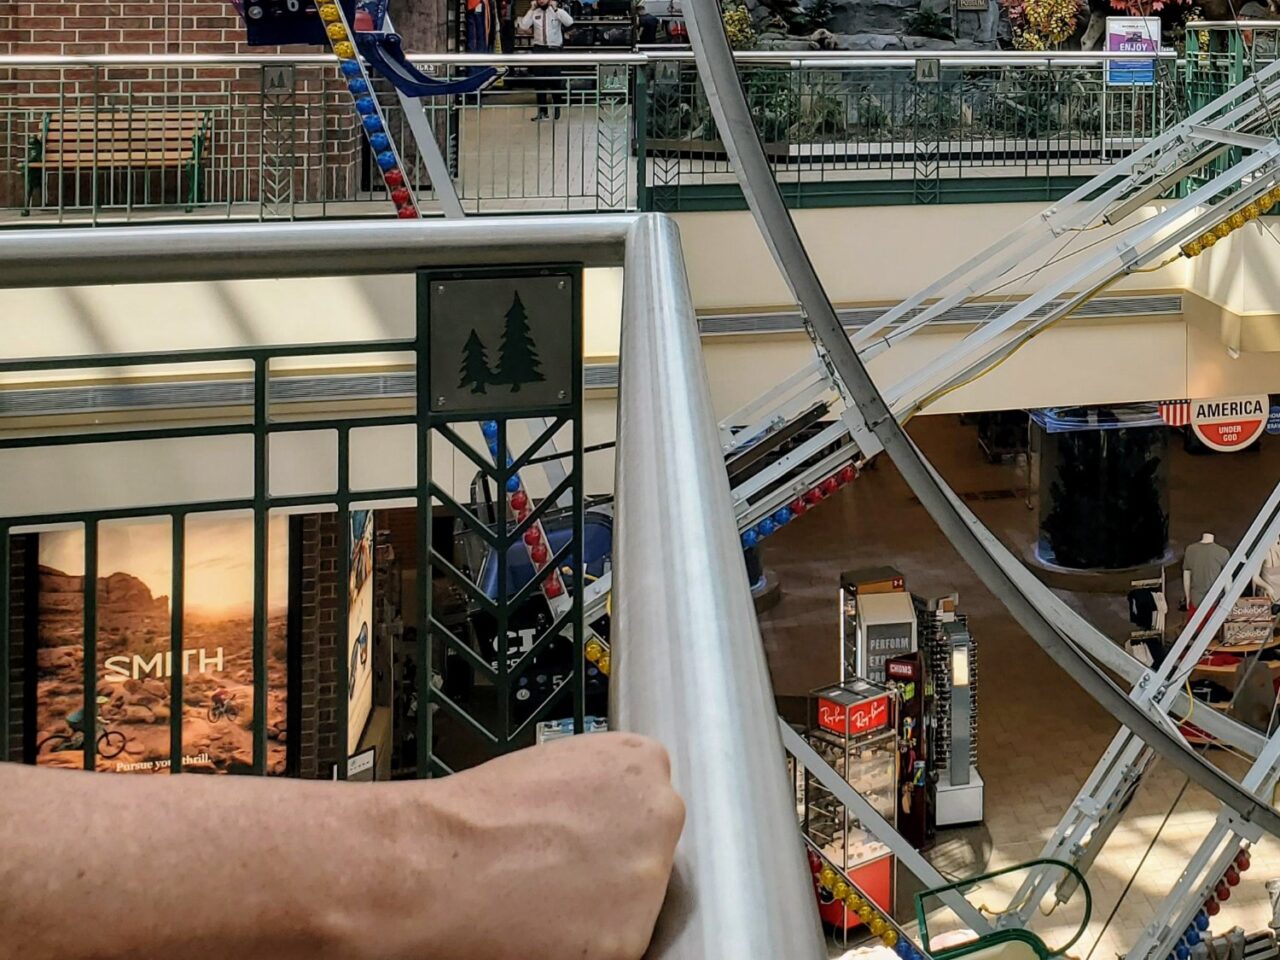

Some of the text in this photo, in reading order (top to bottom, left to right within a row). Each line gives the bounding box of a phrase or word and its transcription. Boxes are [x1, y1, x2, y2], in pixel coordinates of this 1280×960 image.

[1120, 43, 1148, 51] ENJOY
[1196, 400, 1263, 419] AMERICA
[1219, 425, 1241, 434] UNDER
[870, 637, 909, 650] PERFORM
[104, 646, 224, 682] SMITH
[116, 760, 153, 772] Pursue
[181, 753, 212, 766] thrill.
